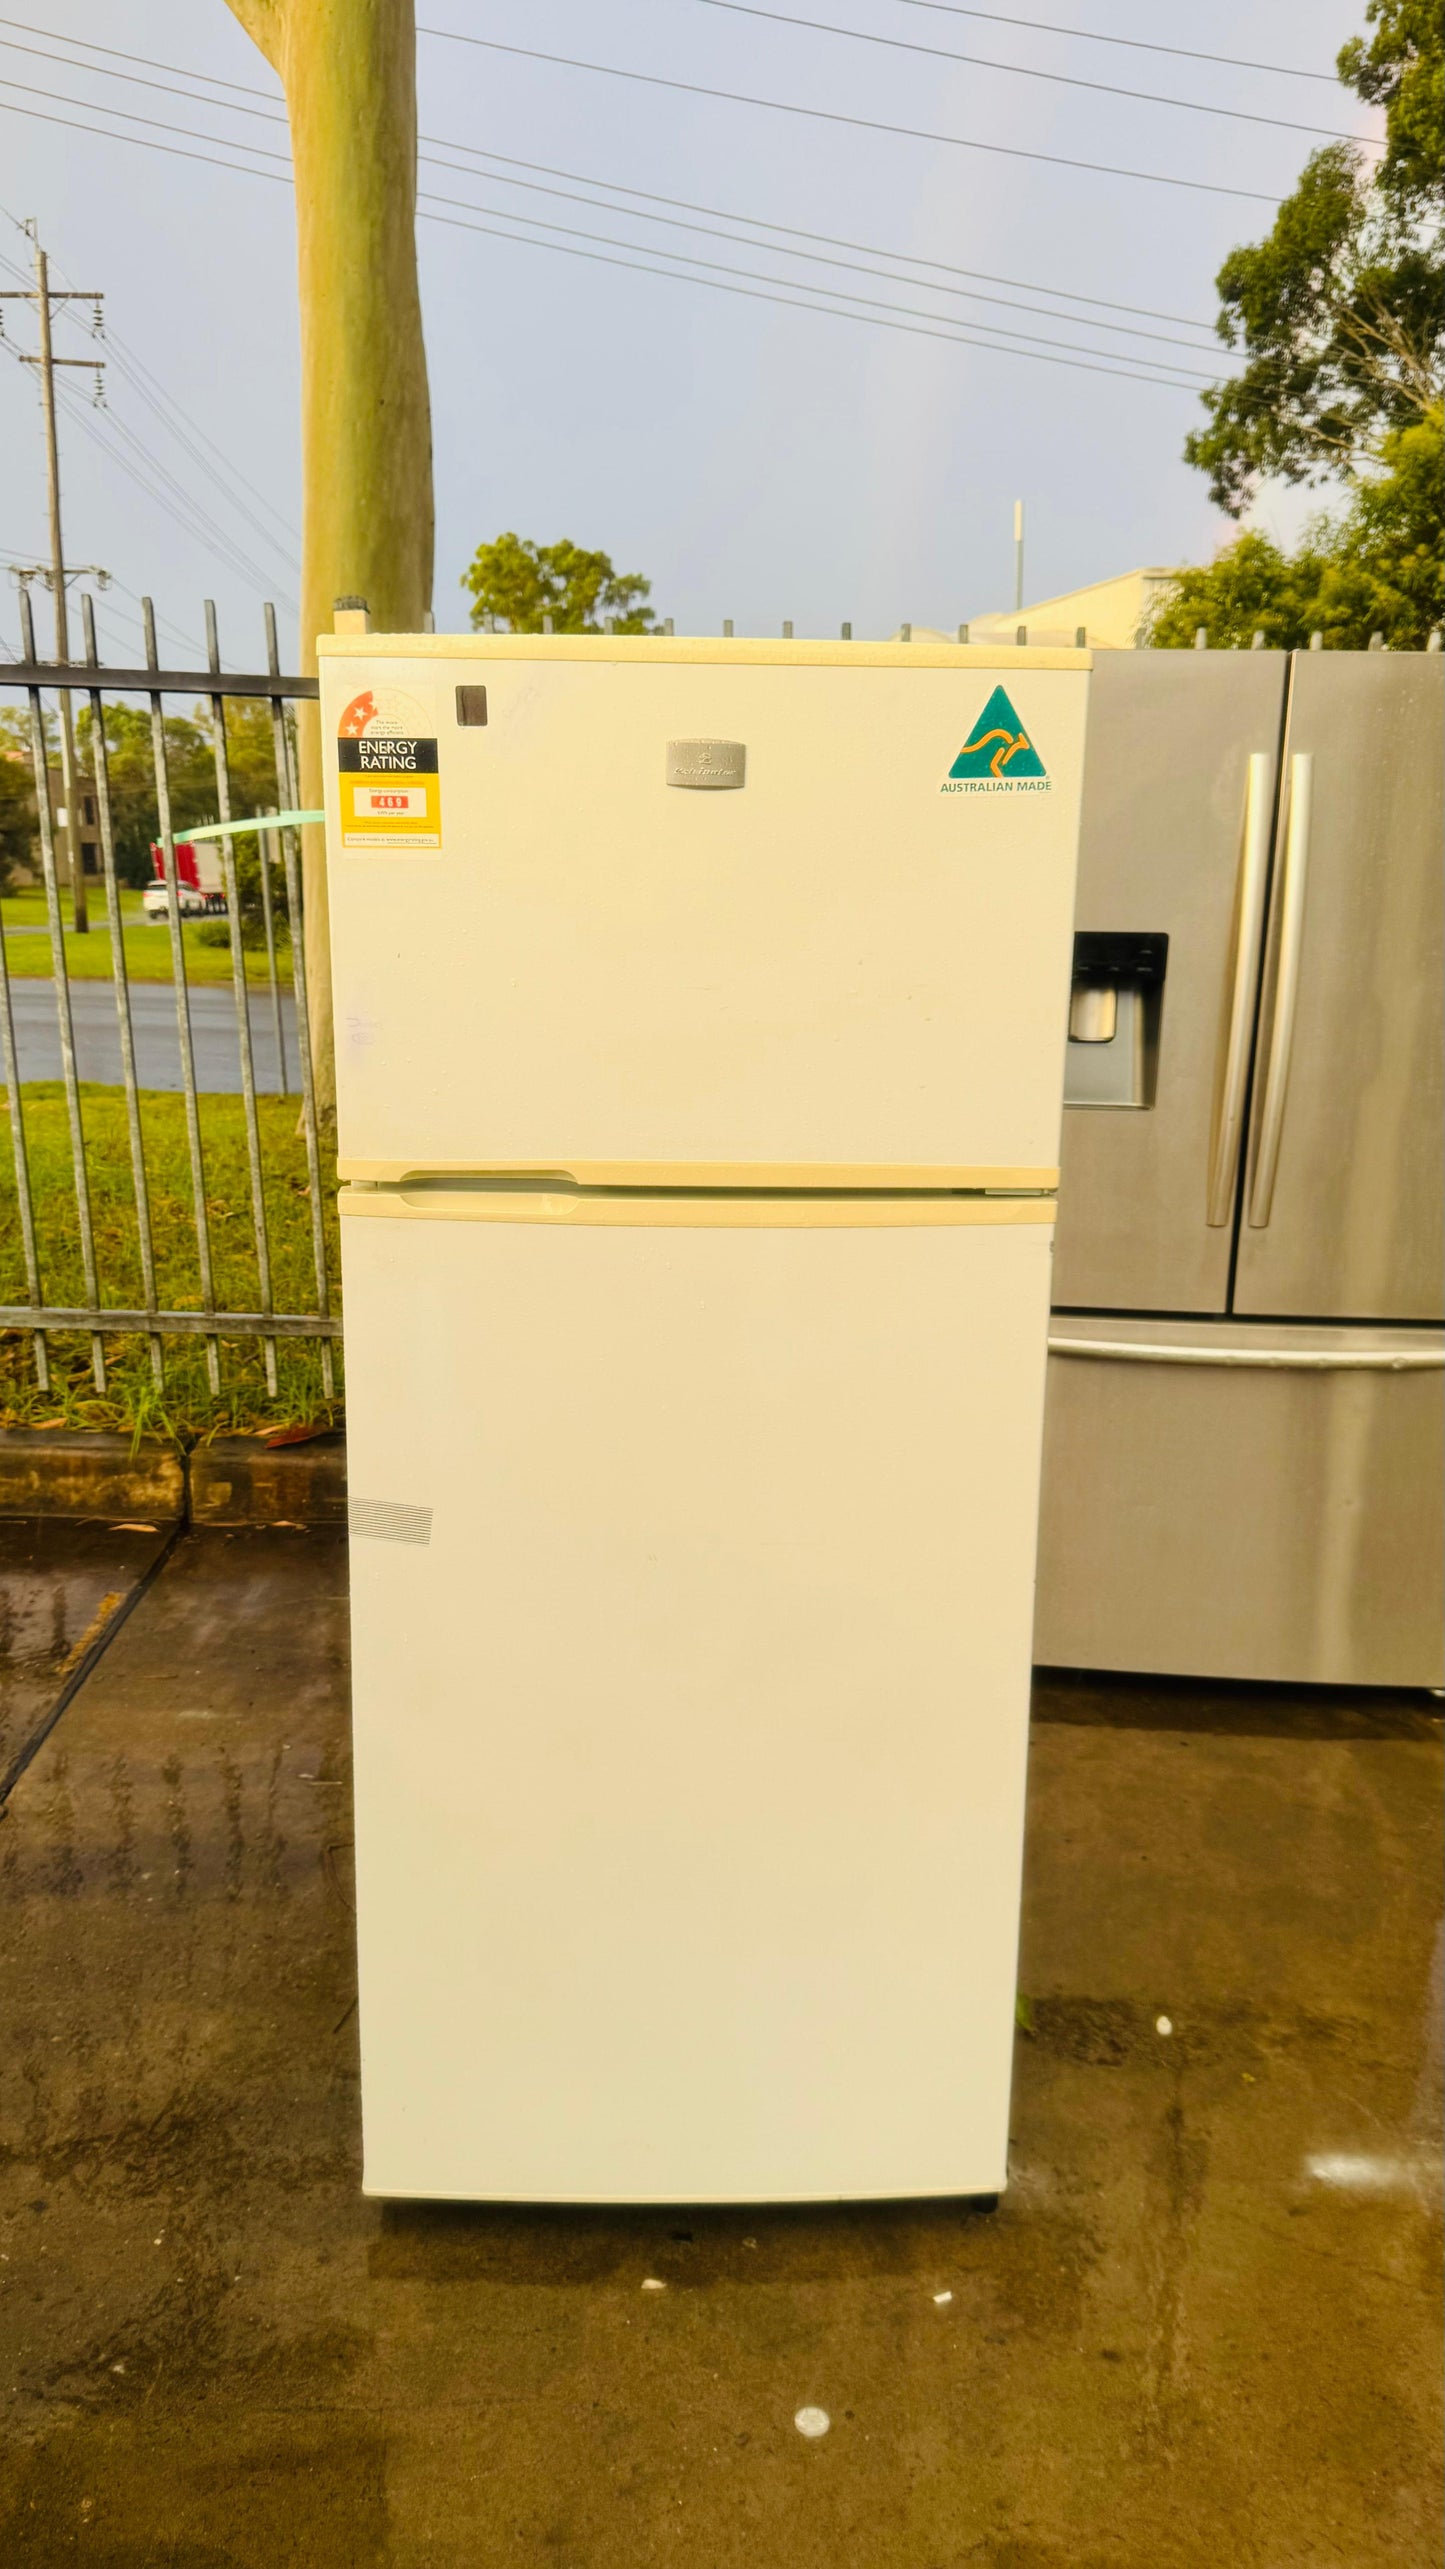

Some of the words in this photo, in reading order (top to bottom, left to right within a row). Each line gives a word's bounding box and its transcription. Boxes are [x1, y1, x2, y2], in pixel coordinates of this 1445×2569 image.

[358, 740, 418, 755] ENERGY
[360, 755, 417, 770] RATING
[940, 782, 1013, 793] AUSTRALIAN
[1016, 781, 1052, 791] MADE
